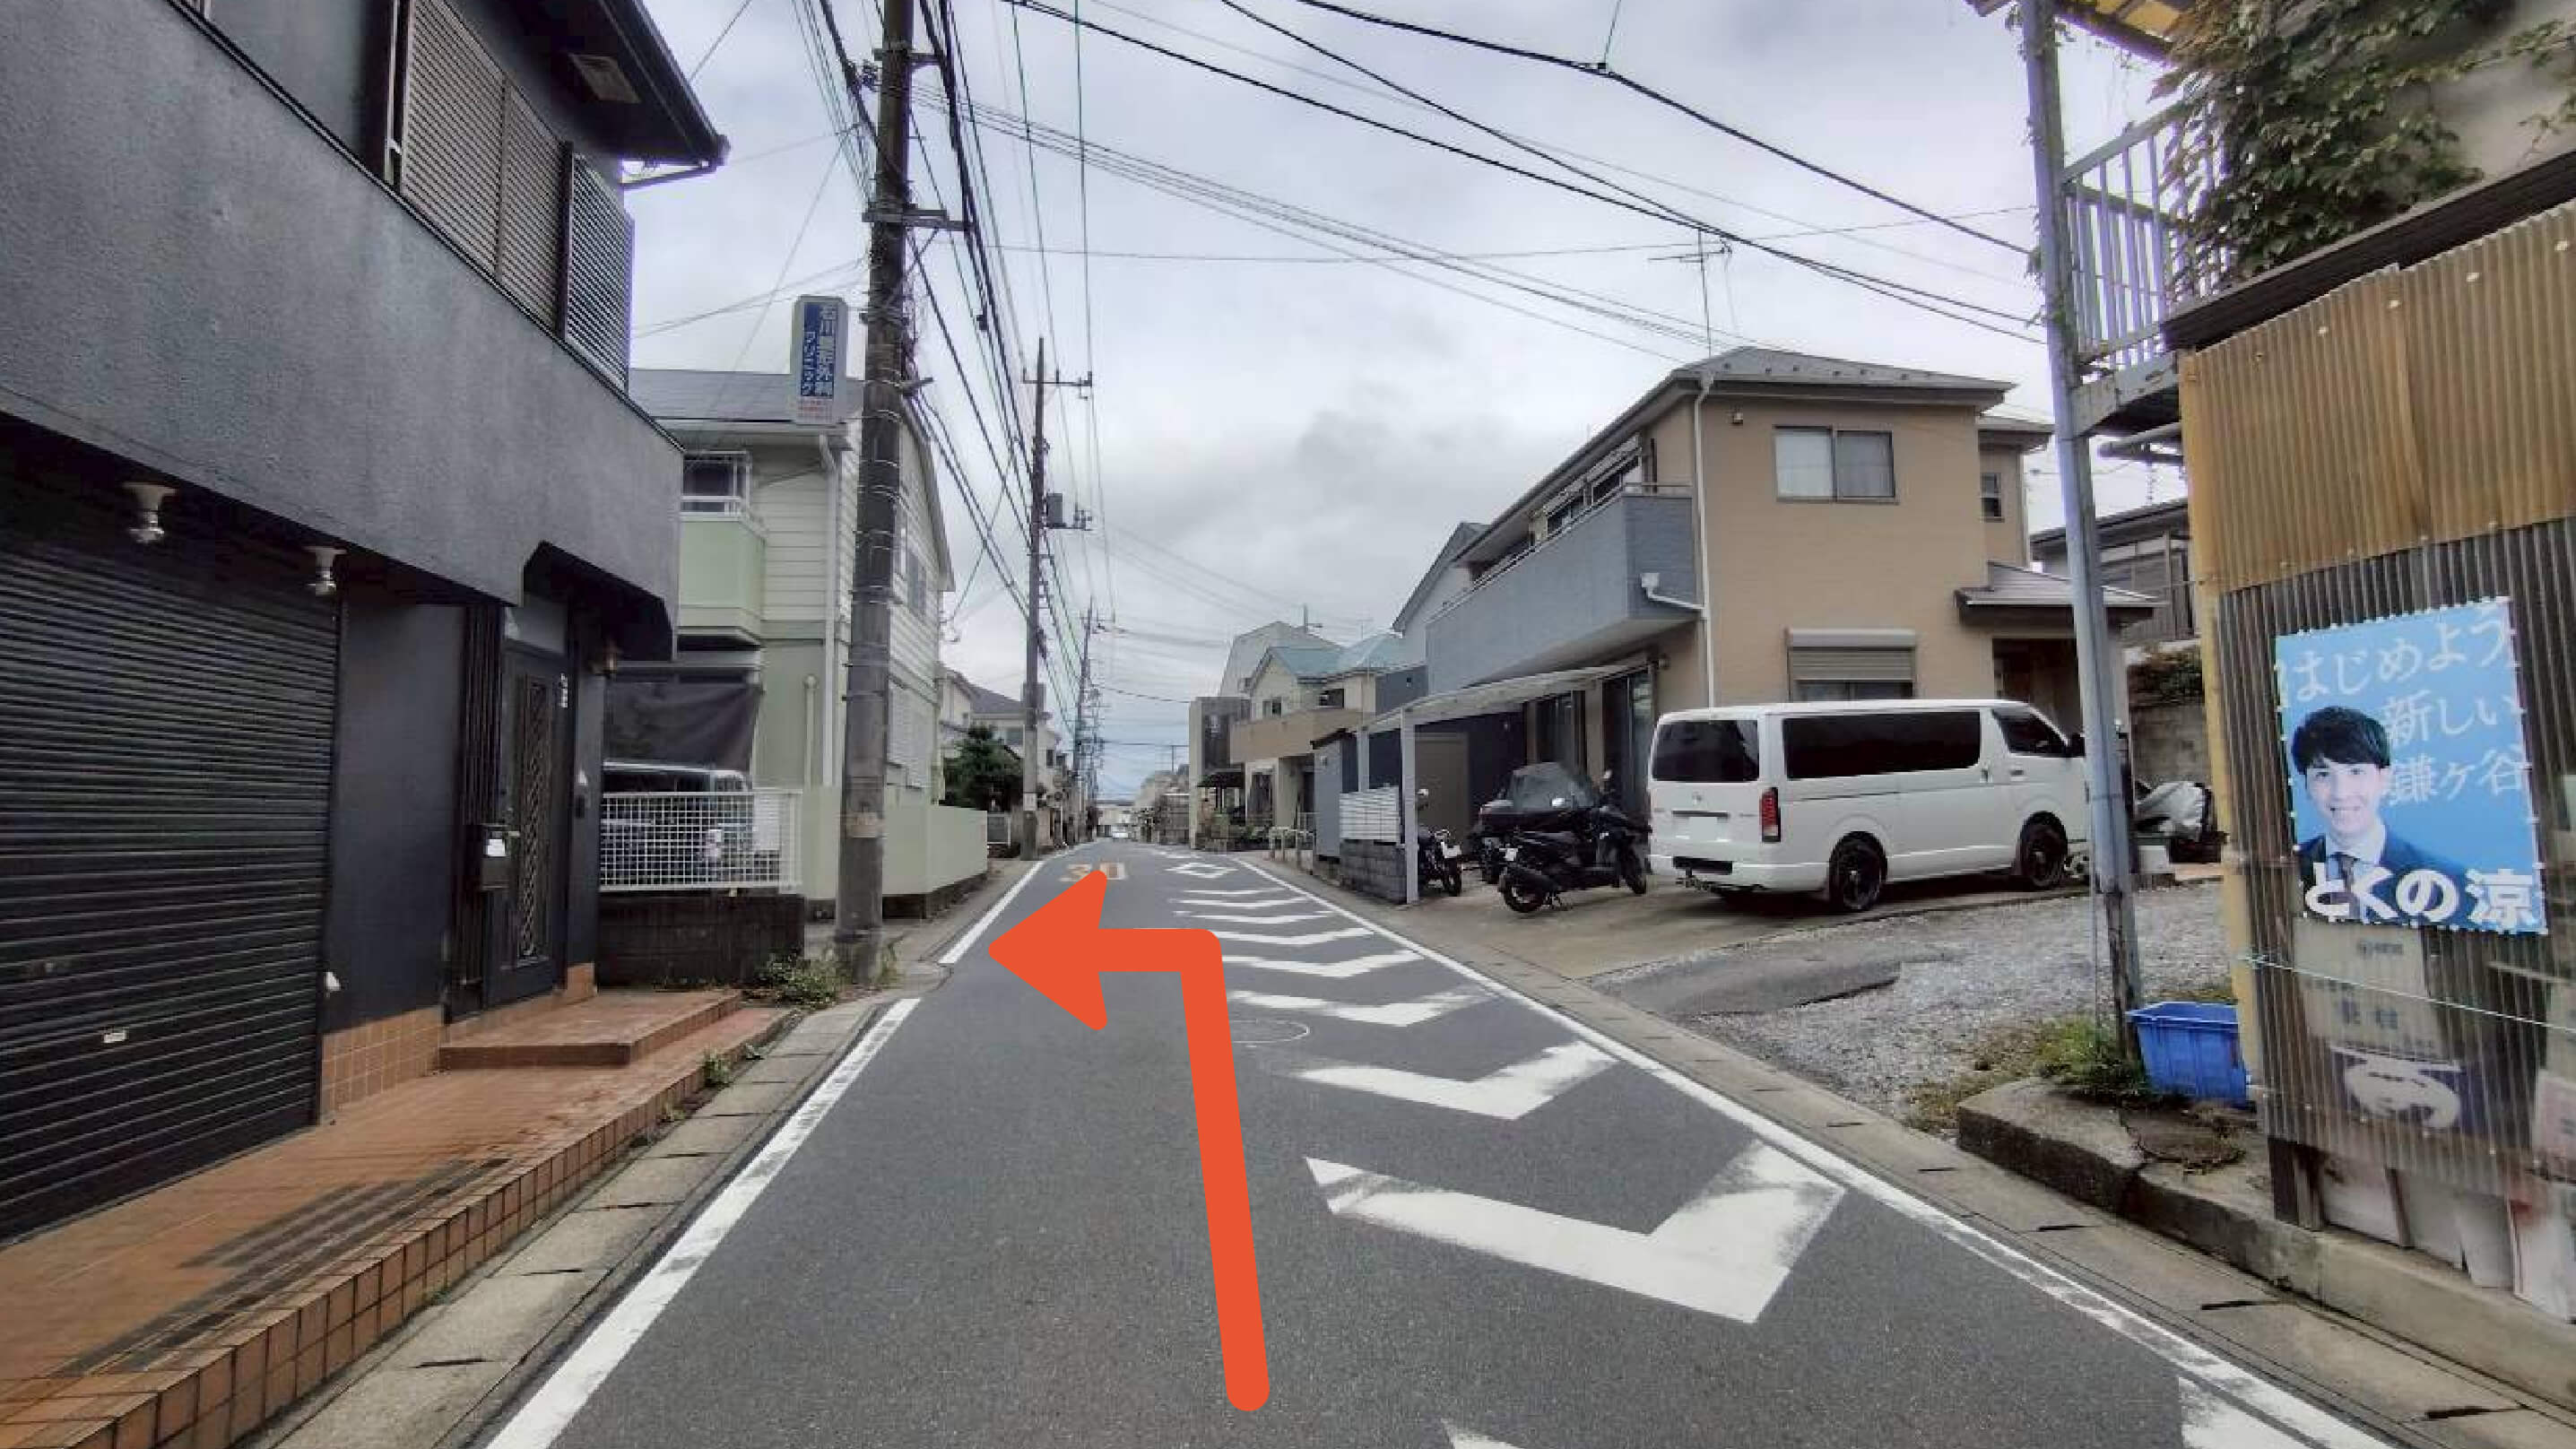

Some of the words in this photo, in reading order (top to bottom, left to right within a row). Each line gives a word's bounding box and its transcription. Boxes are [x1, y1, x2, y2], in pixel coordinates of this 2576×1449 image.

[2276, 601, 2510, 703] はじめよう
[2384, 689, 2523, 747] 新しい
